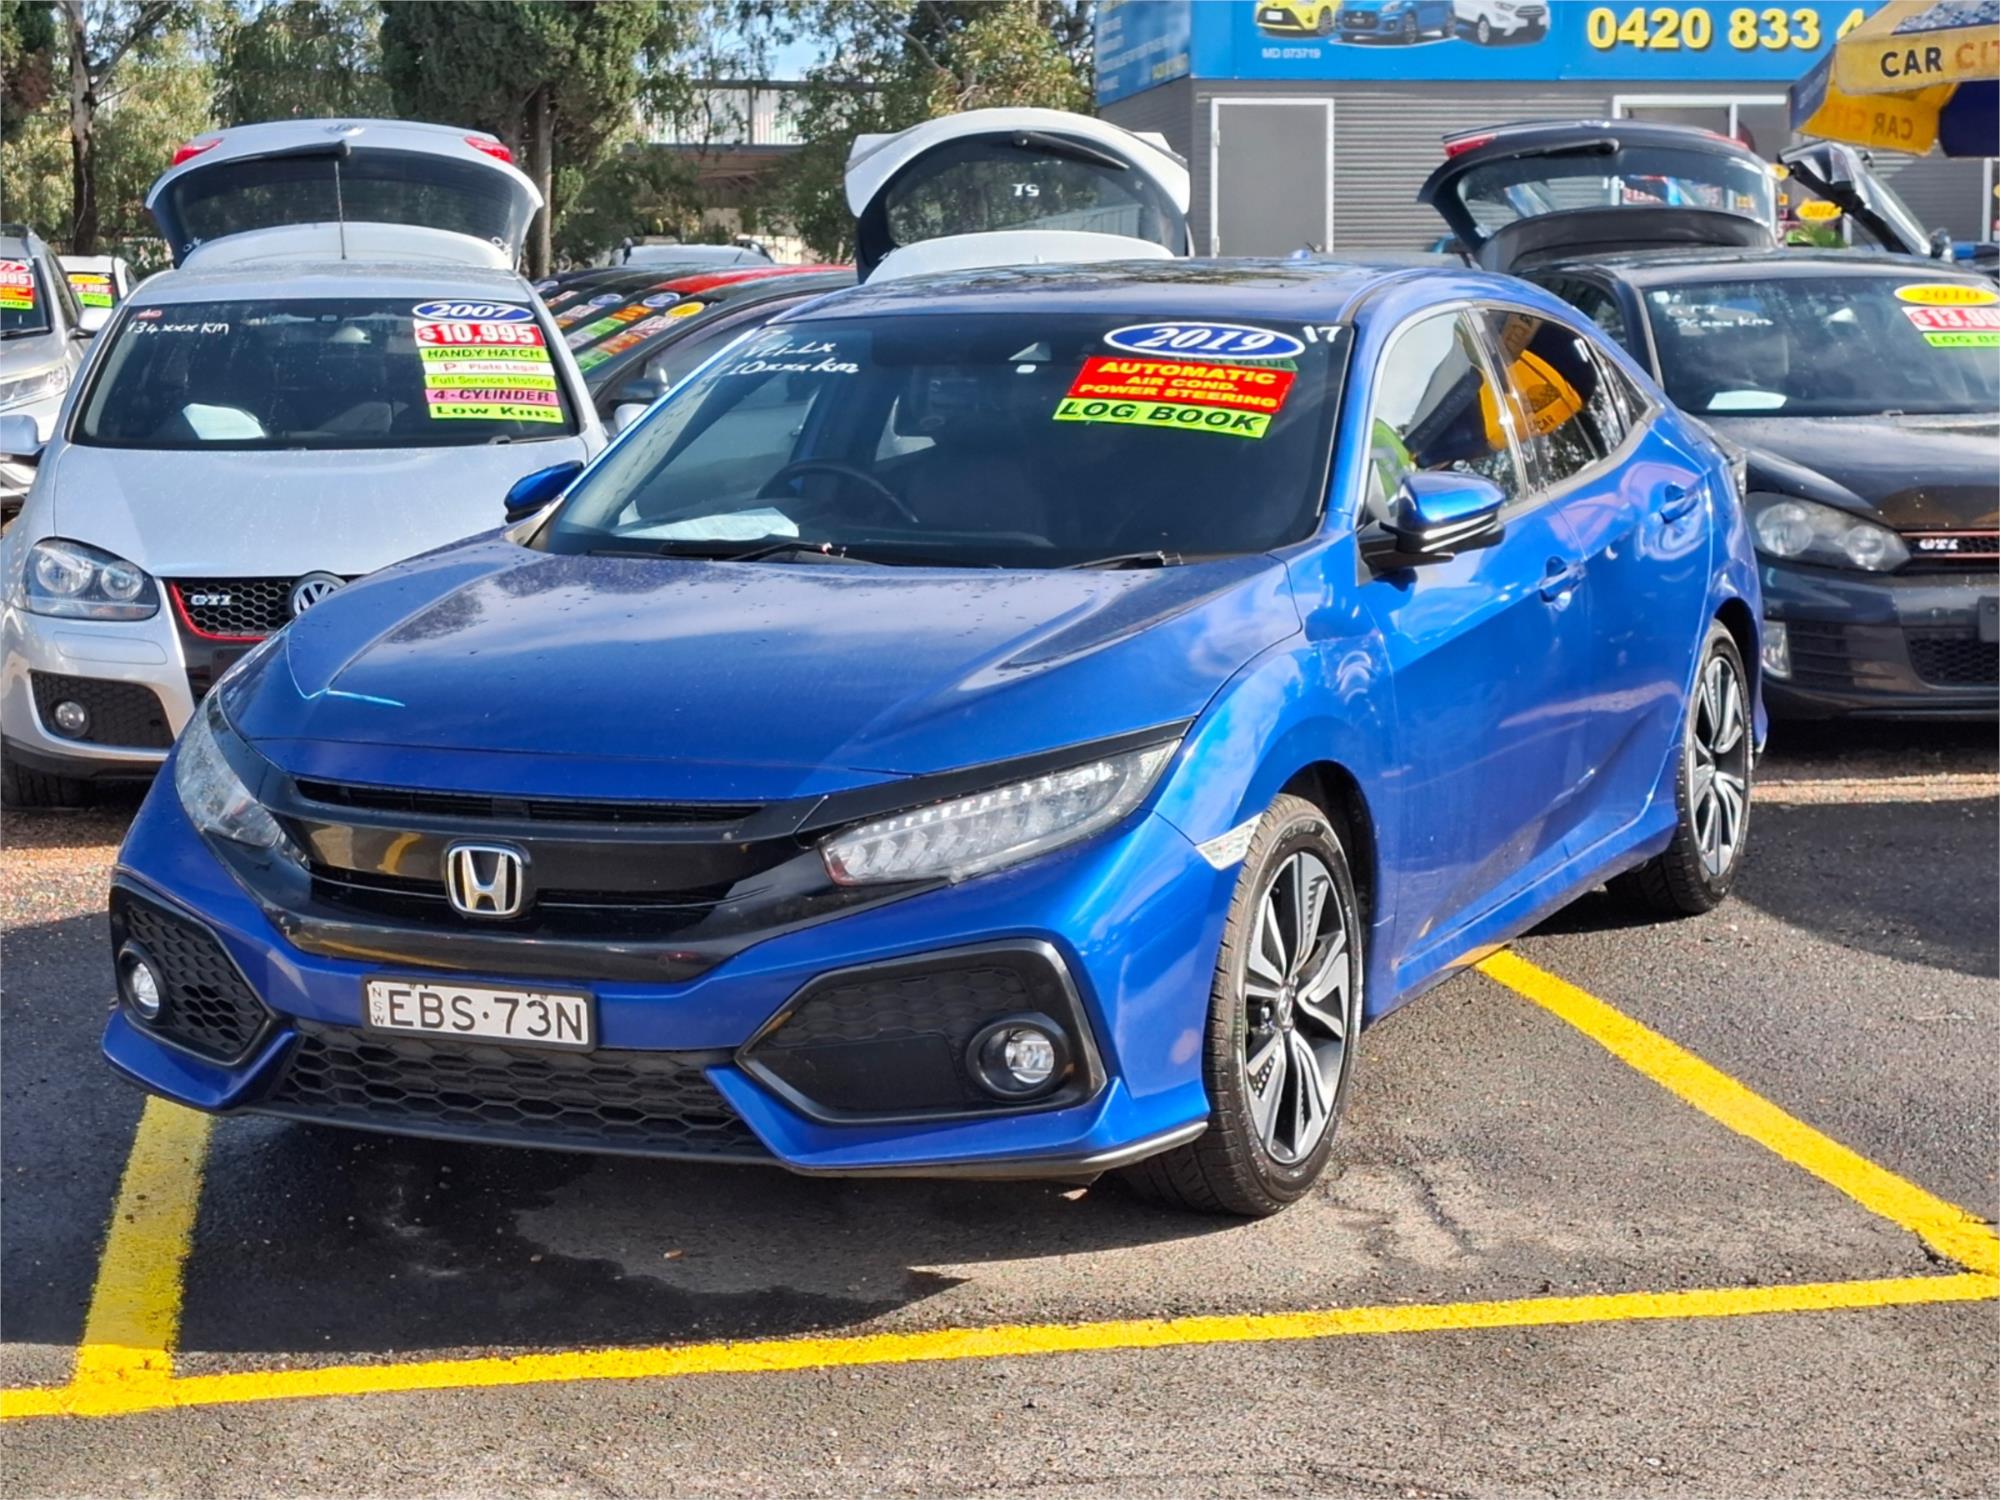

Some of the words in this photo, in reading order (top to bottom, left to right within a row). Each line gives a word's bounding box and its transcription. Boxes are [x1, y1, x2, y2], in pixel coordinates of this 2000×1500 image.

[1587, 8, 1713, 48] 0420
[1728, 8, 1821, 49] 833
[1880, 47, 1943, 78] CAR
[427, 304, 514, 318] 2007
[418, 324, 535, 344] $10,995
[1141, 328, 1276, 351] 2019
[1303, 325, 1342, 343] 17
[427, 349, 486, 359] HANDY
[488, 349, 541, 359] HATCH
[431, 376, 455, 384] Full
[458, 376, 504, 385] Service
[507, 377, 551, 387] History
[1097, 361, 1277, 385] AUTOMATIC
[1126, 376, 1165, 386] AIR
[1170, 378, 1239, 391] COND.
[1079, 384, 1158, 397] POWER
[1163, 388, 1278, 408] STEERING
[1059, 401, 1137, 418] LOG
[1147, 407, 1263, 430] BOOK
[191, 594, 232, 606] GTI
